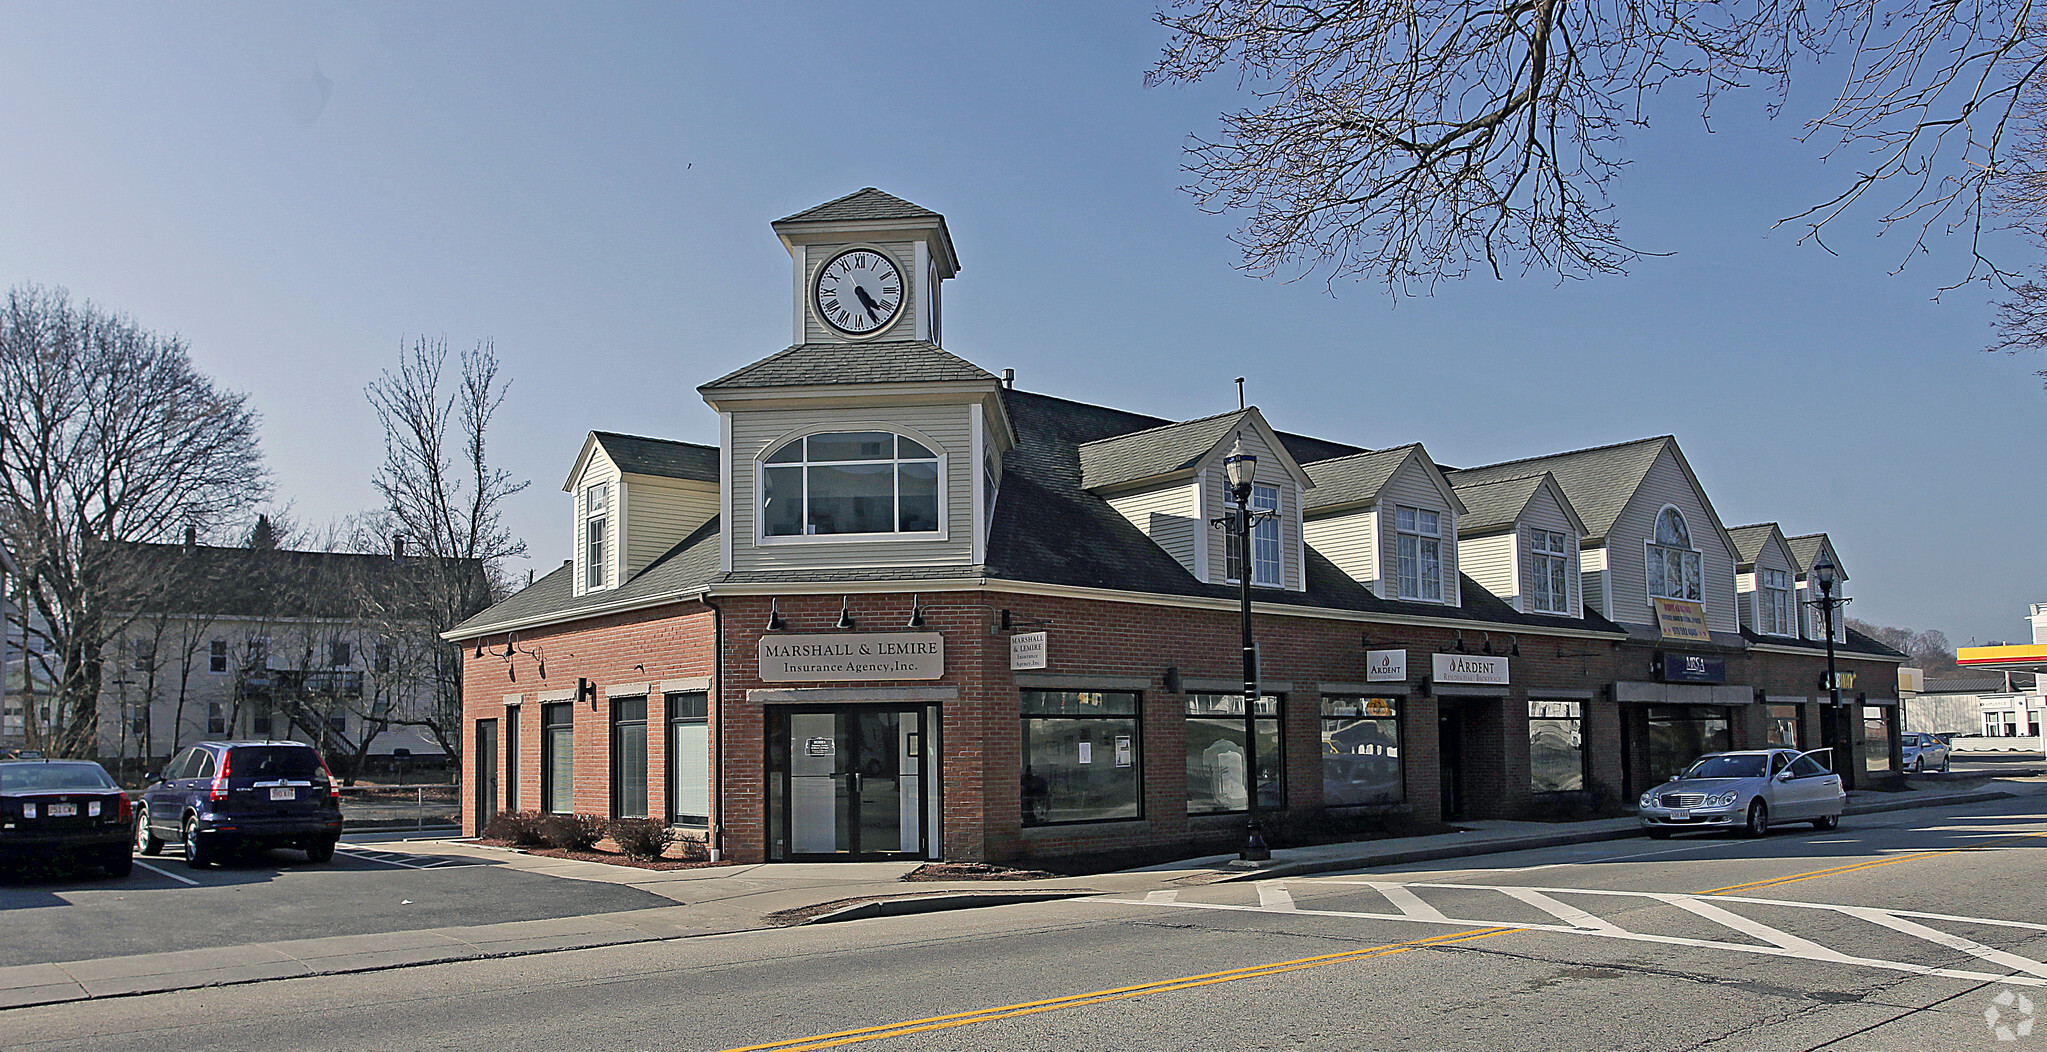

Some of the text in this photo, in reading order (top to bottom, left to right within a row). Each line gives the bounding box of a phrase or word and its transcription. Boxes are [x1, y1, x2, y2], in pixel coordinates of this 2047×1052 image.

[1012, 636, 1043, 644] MARSHALL
[766, 642, 938, 658] MARSHALL & LEMIRE
[1020, 644, 1042, 652] LEMIRE
[784, 662, 843, 672] Insurance
[1371, 666, 1401, 674] ARDENT
[1458, 658, 1494, 674] ARDENT
[1826, 672, 1857, 689] SBWAY
